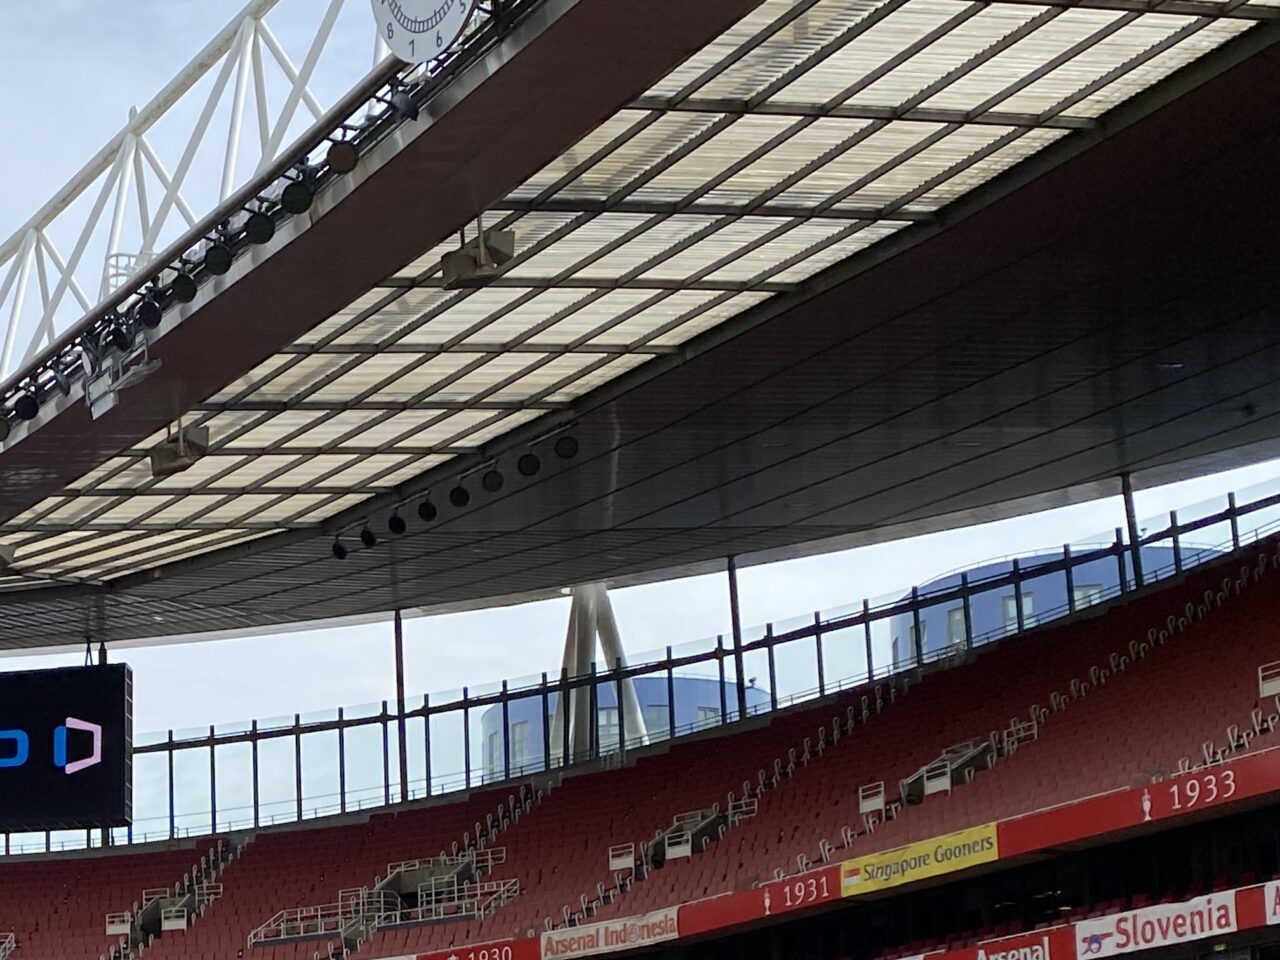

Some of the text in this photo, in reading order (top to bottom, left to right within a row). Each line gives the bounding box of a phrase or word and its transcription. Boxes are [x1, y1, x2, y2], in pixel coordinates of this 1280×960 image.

[436, 30, 443, 48] 6
[1169, 769, 1237, 810] 1933
[863, 834, 994, 882] Singapore Gooners
[783, 875, 830, 907] 1931
[1115, 898, 1231, 949] Slovenia
[544, 927, 600, 957] Arsenal
